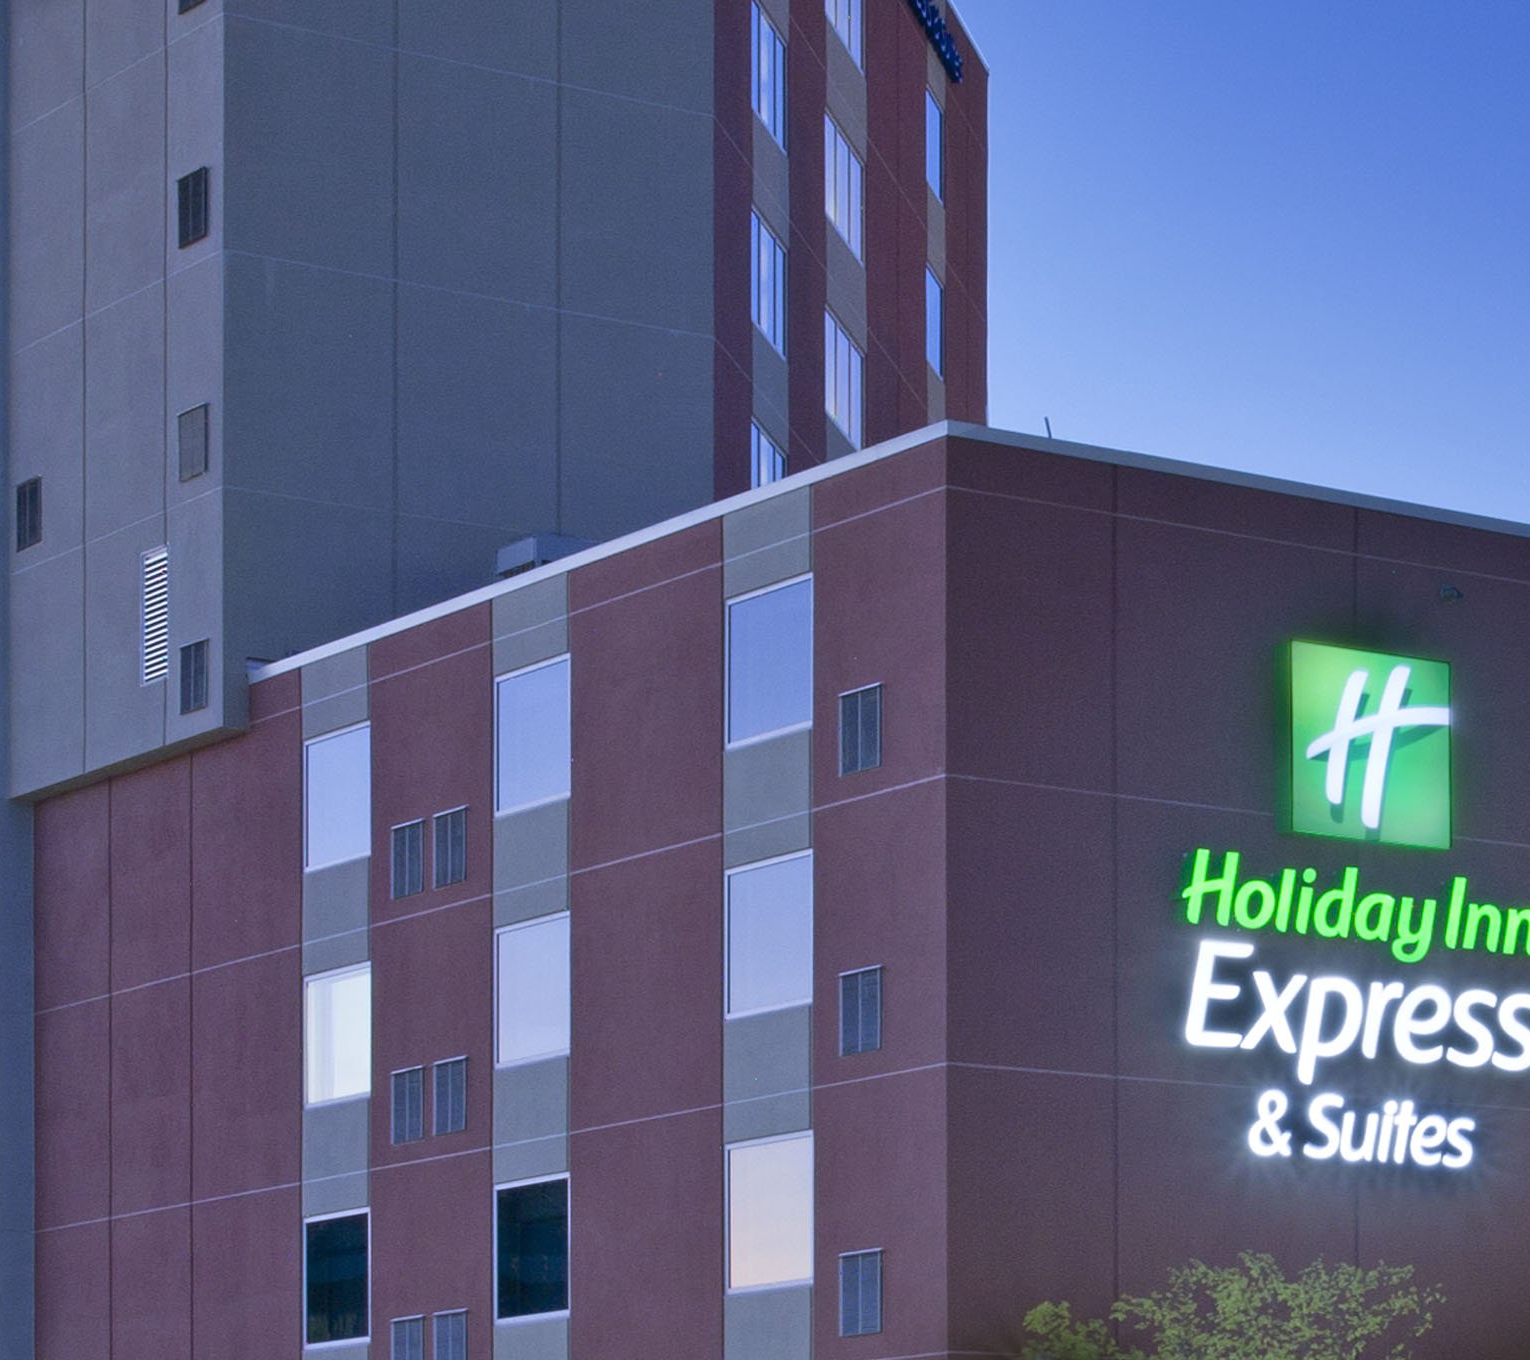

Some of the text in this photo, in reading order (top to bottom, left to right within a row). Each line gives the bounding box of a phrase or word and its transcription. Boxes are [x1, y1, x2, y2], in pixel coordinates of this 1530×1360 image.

[1181, 847, 1437, 964] Holiday
[1247, 1088, 1477, 1170] & Suites
